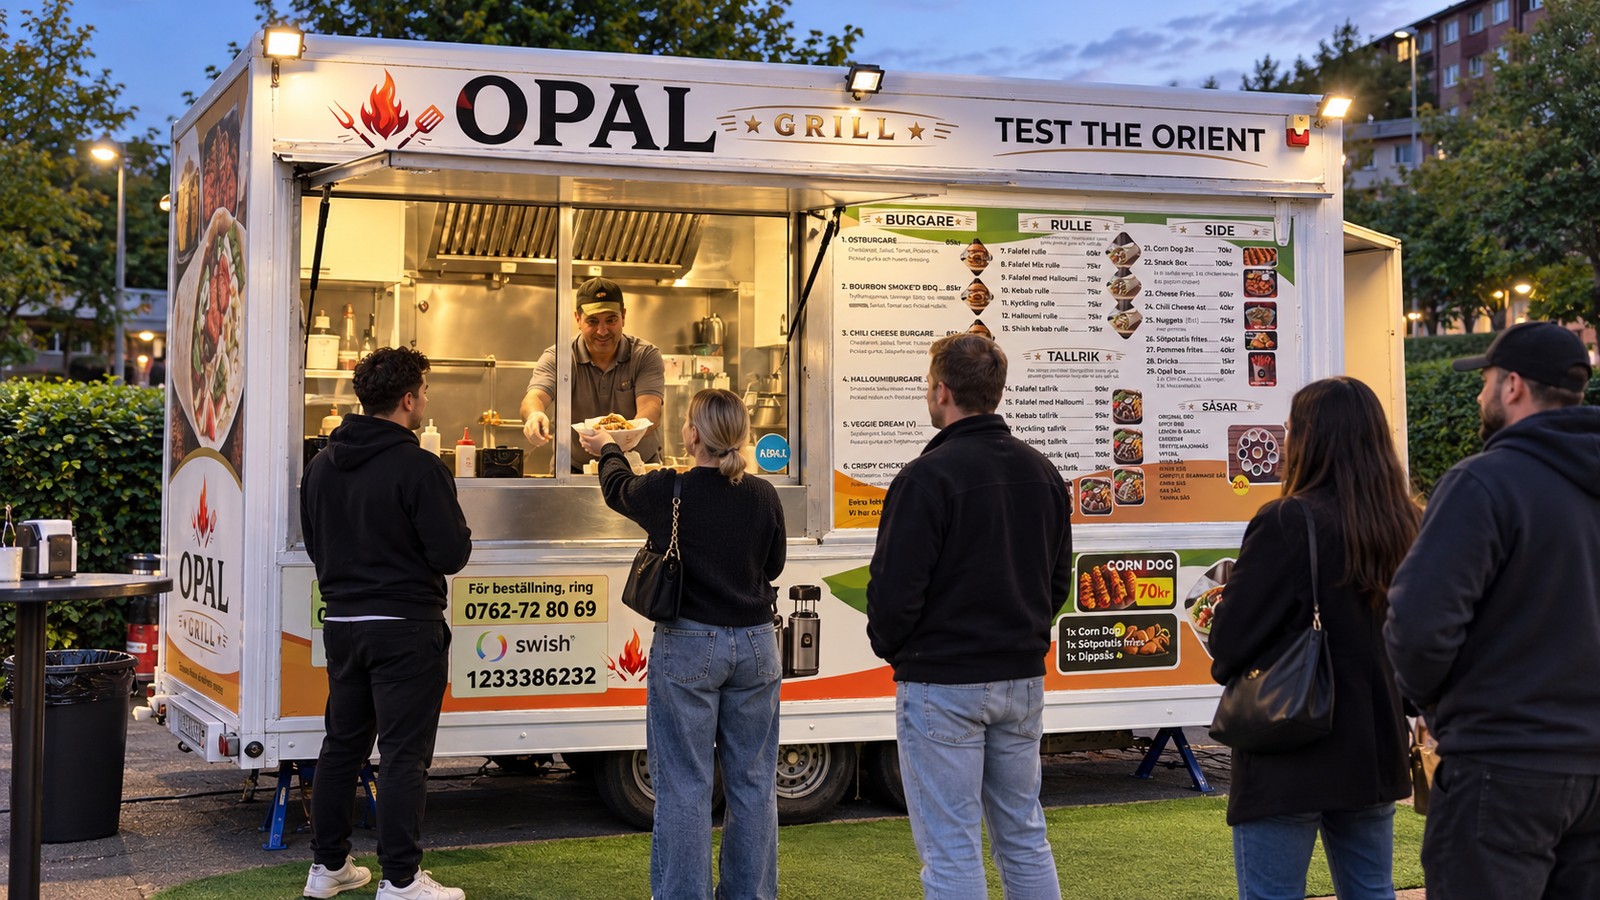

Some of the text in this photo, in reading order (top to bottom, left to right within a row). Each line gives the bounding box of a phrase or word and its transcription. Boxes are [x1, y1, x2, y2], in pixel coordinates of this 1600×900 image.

[456, 75, 716, 153] OPAL
[774, 112, 897, 141] GRILL
[995, 116, 1266, 153] TEST THE ORIENT
[886, 215, 954, 226] BURGARE
[1051, 220, 1091, 231] RULLE
[1205, 225, 1234, 236] SIDE
[1047, 352, 1100, 362] TALLRIK
[1202, 400, 1237, 411] SÅSAR
[1107, 559, 1173, 571] CORN DOG
[179, 551, 229, 614] OPAL
[469, 582, 593, 596] För beställning, ring
[1138, 583, 1170, 599] 70kr
[465, 600, 596, 620] 0762-72 80 69
[188, 616, 215, 646] GRILL
[1067, 628, 1076, 636] 1x
[1079, 627, 1099, 636] Corn
[515, 634, 571, 653] swish
[1067, 640, 1076, 648] 1x
[1067, 653, 1076, 661] 1x
[467, 667, 596, 688] 1233386232
